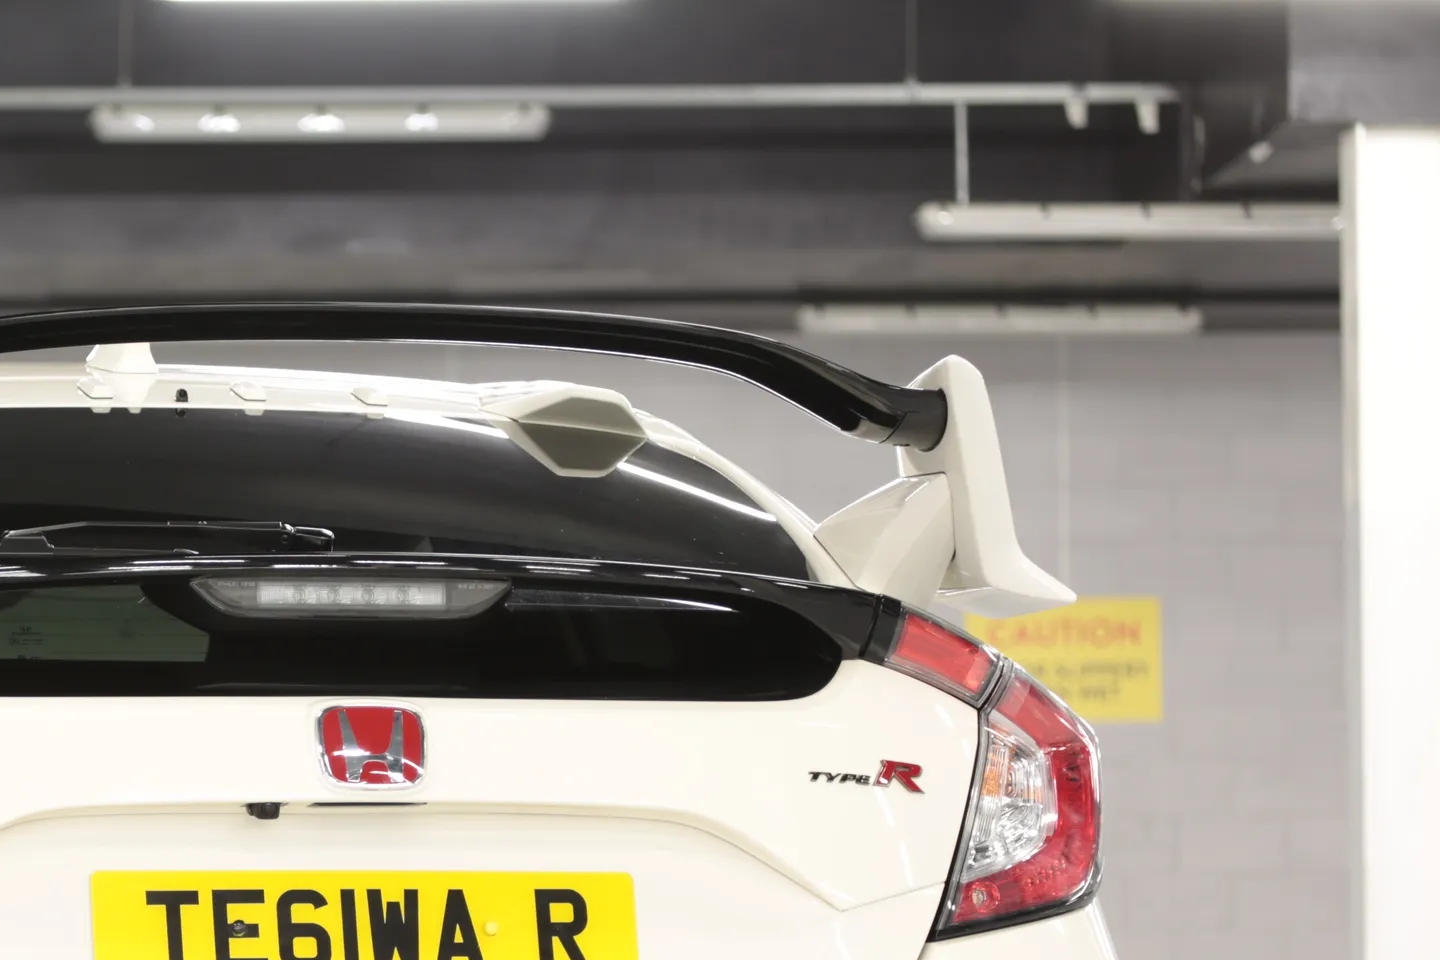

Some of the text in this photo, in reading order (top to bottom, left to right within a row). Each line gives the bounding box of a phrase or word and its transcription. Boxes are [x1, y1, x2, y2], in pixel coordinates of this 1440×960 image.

[985, 615, 1143, 648] CAUTION
[808, 758, 926, 795] TYPE R
